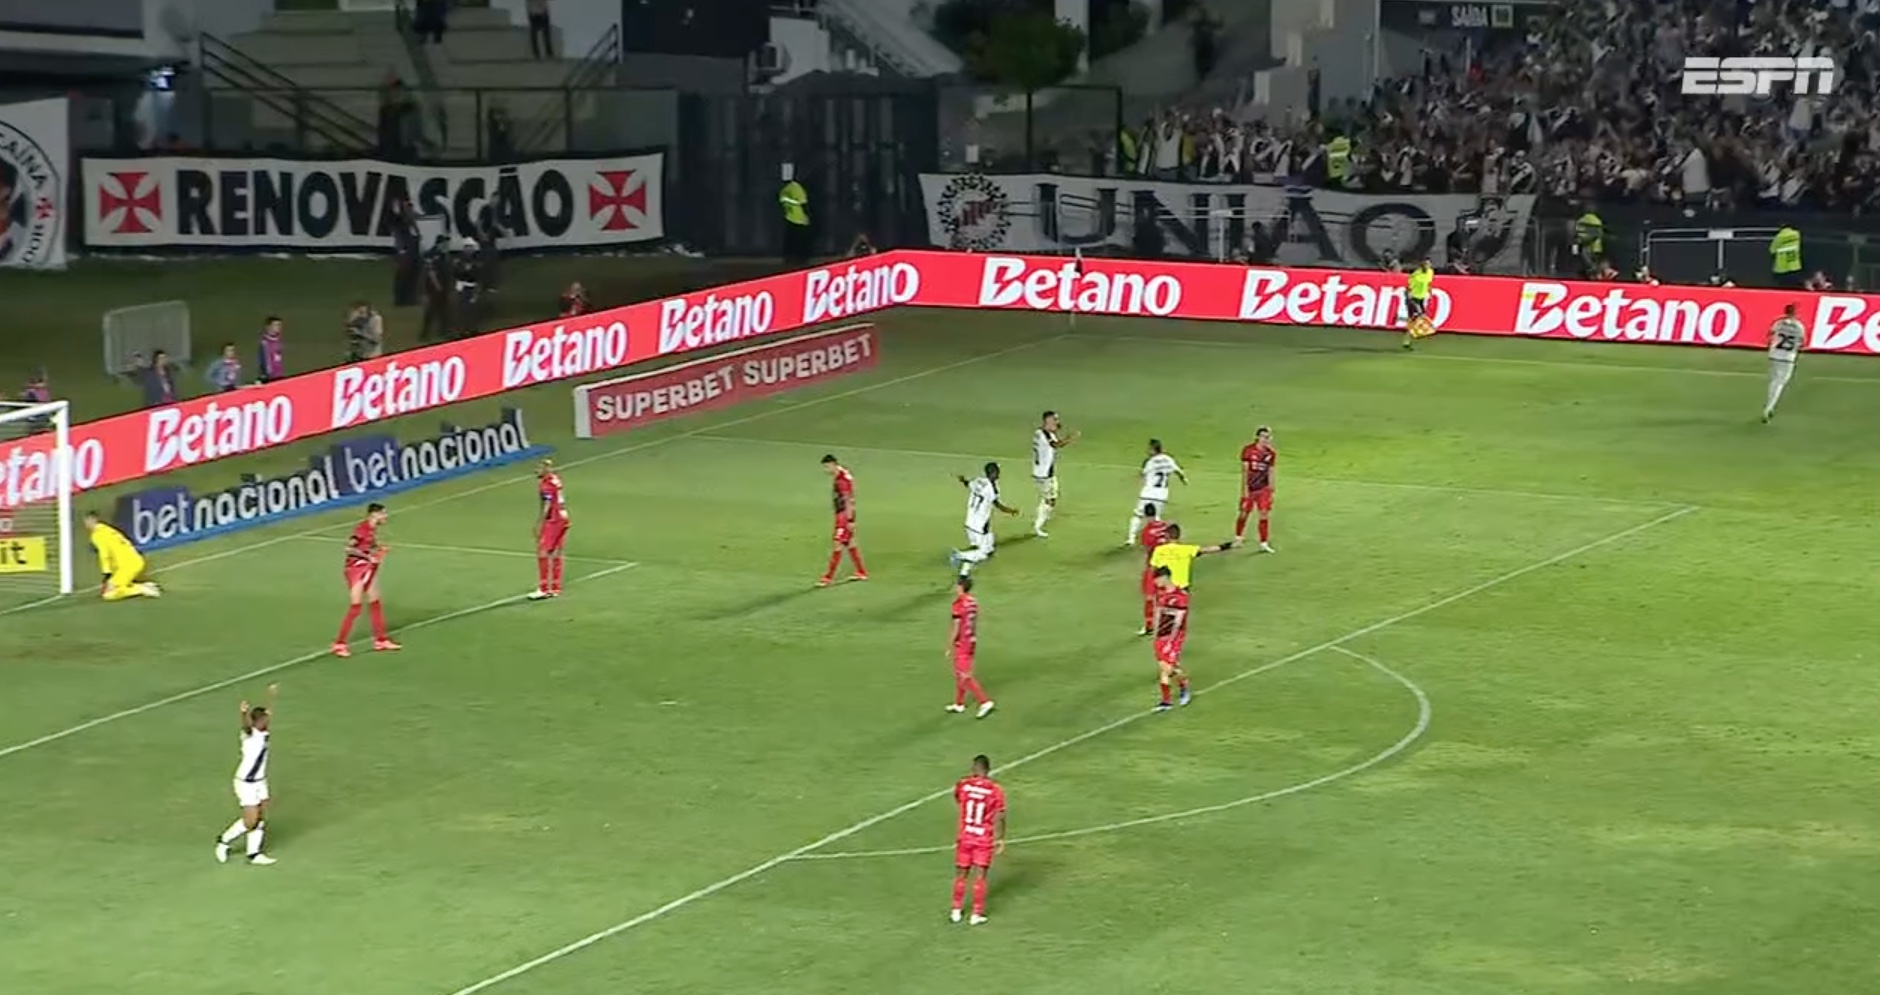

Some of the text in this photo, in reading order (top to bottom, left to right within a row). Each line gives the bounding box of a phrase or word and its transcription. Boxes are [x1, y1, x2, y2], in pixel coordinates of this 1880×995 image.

[804, 263, 919, 323] Betano
[979, 256, 1181, 316] Betano
[1240, 269, 1451, 329] Betano
[1514, 282, 1741, 344] Betano
[658, 291, 773, 354] Betano
[1776, 333, 1795, 351] 25
[503, 321, 627, 388] Betano
[595, 332, 872, 421] SUPERBET SUPERBET
[331, 356, 466, 429] Betano
[144, 395, 293, 473] Betano
[0, 438, 104, 507] tano
[965, 799, 986, 825] 11
